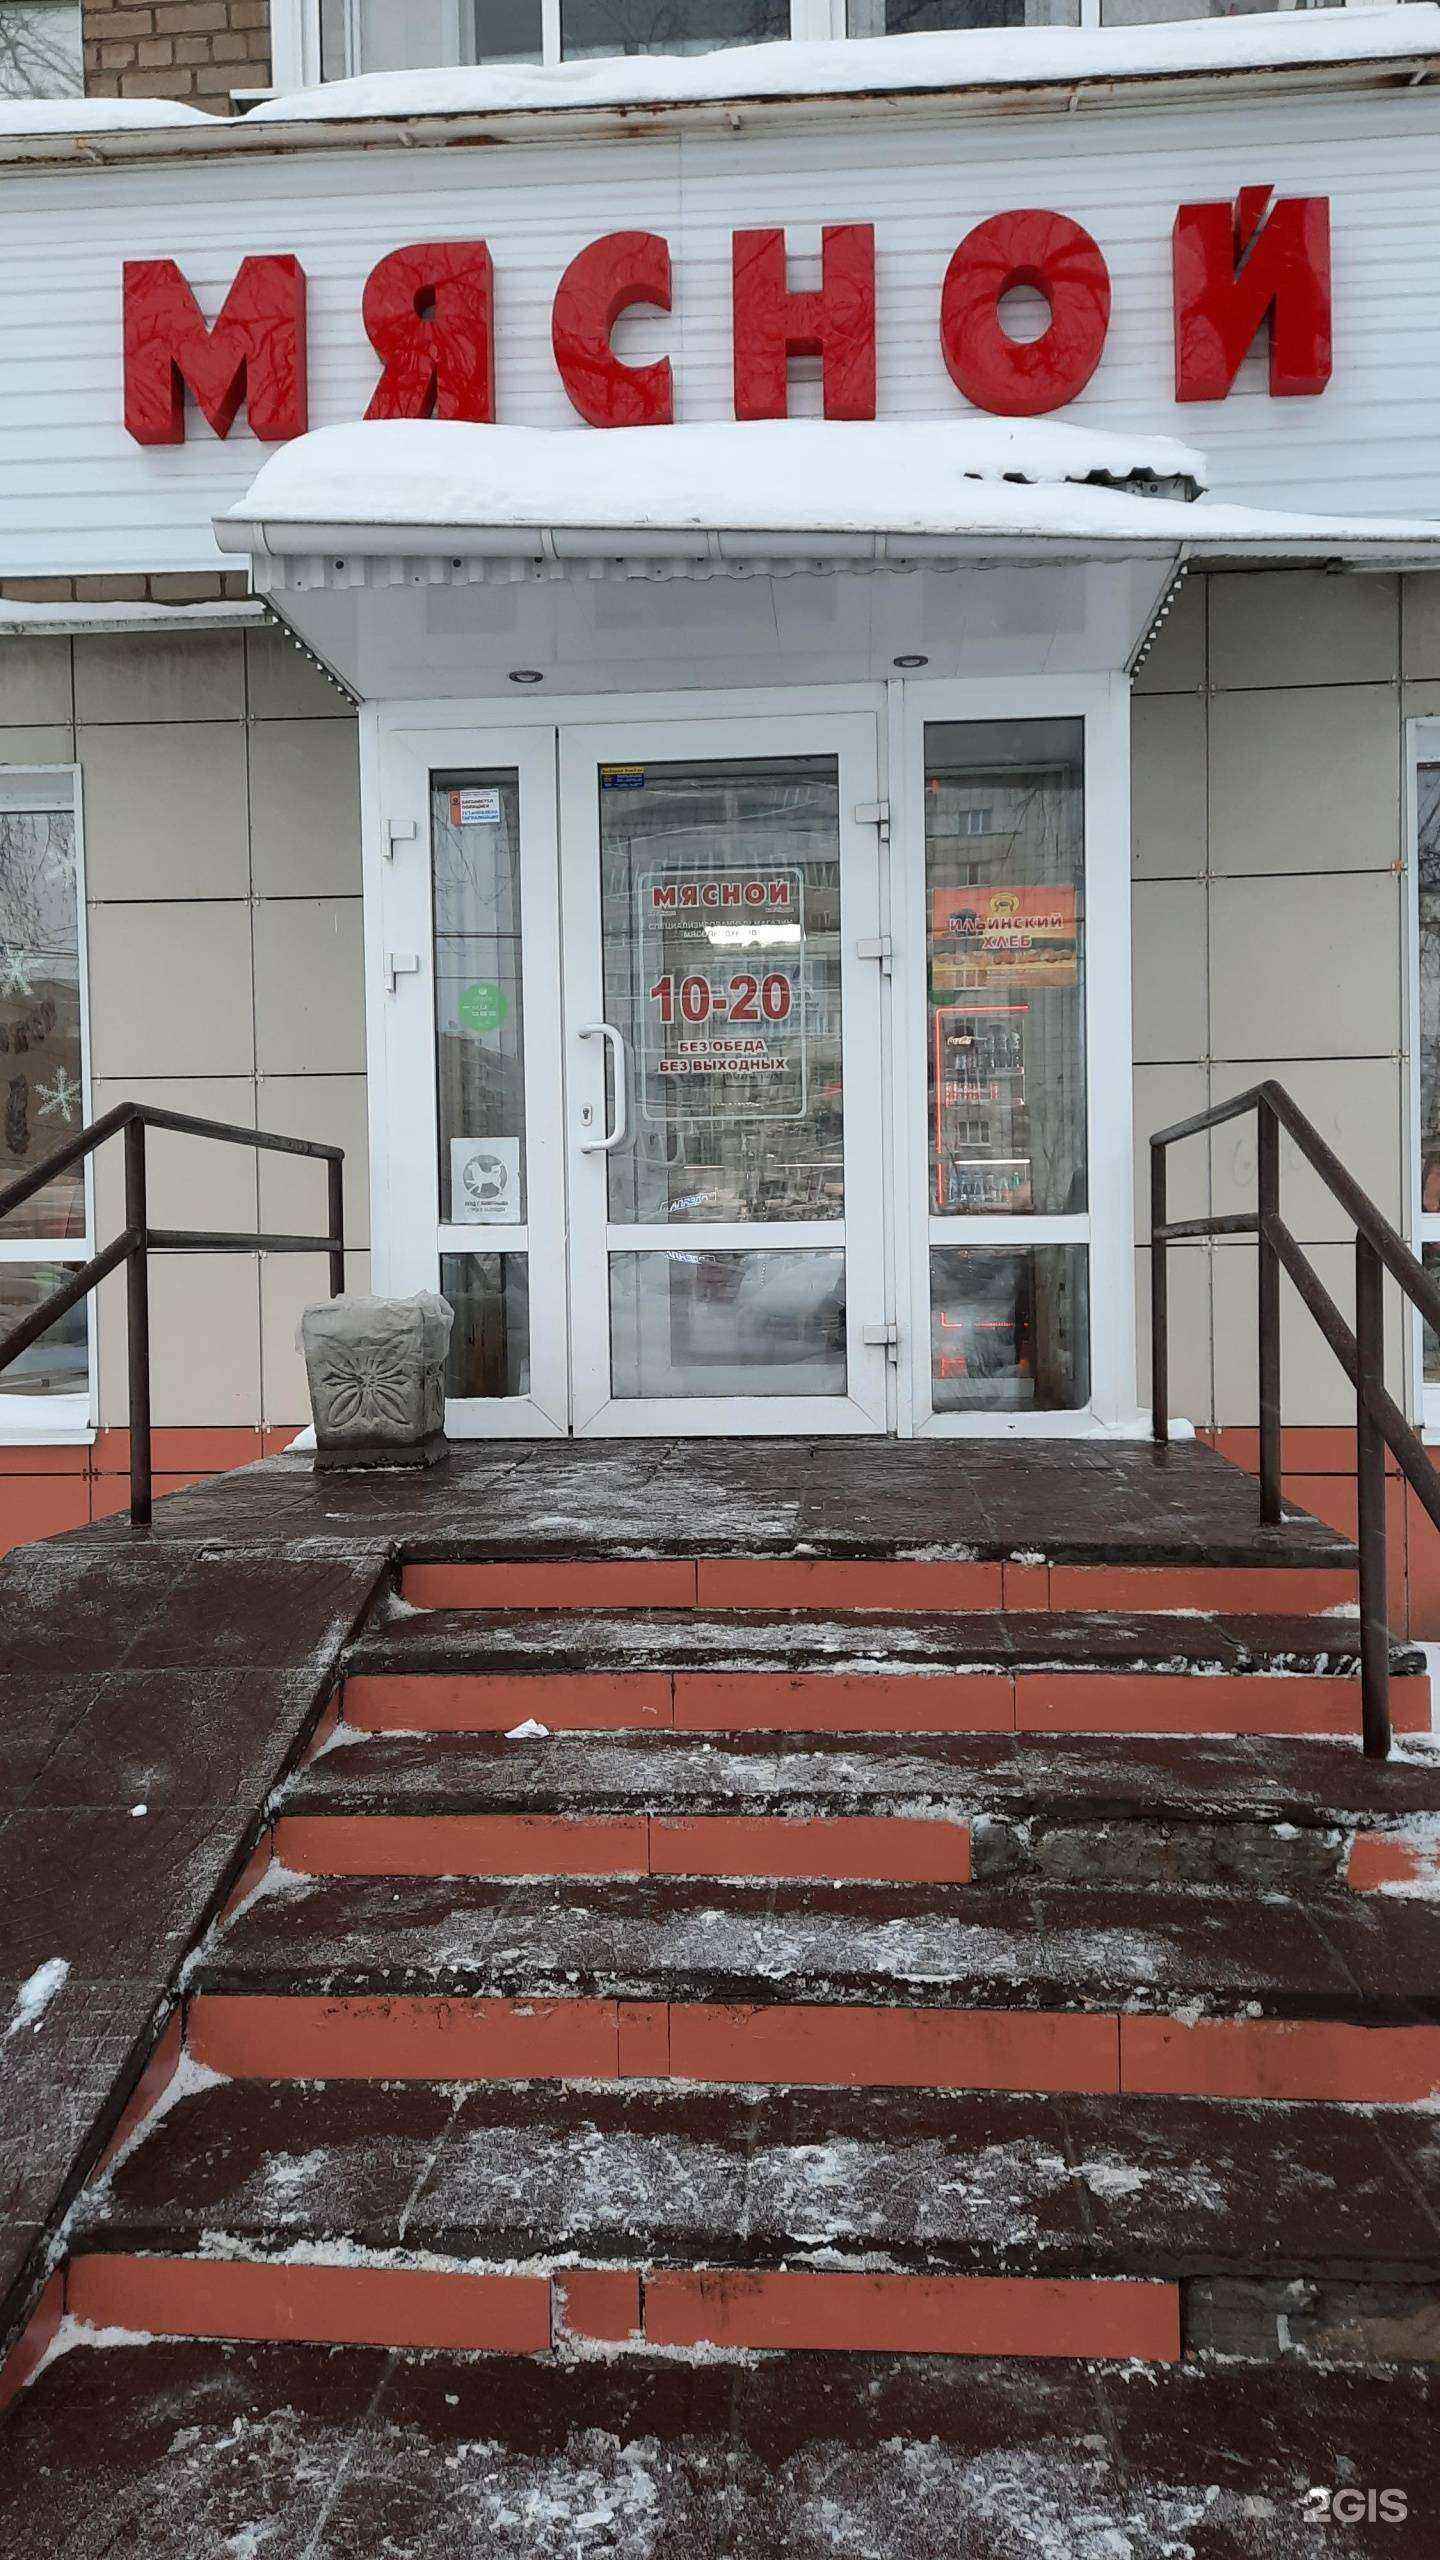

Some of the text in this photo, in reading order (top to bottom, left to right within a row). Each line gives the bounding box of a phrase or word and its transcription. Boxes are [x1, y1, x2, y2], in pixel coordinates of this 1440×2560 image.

[122, 184, 1333, 446] МЯСНОЙ
[652, 880, 790, 909] МЯСНОЙ
[983, 934, 1032, 950] ХЛЕБ
[650, 972, 794, 1024] 10-20
[679, 1040, 765, 1053] БЕЗ ОБЕДА
[659, 1058, 786, 1072] БЕЗ ВЫХОДНЫХ
